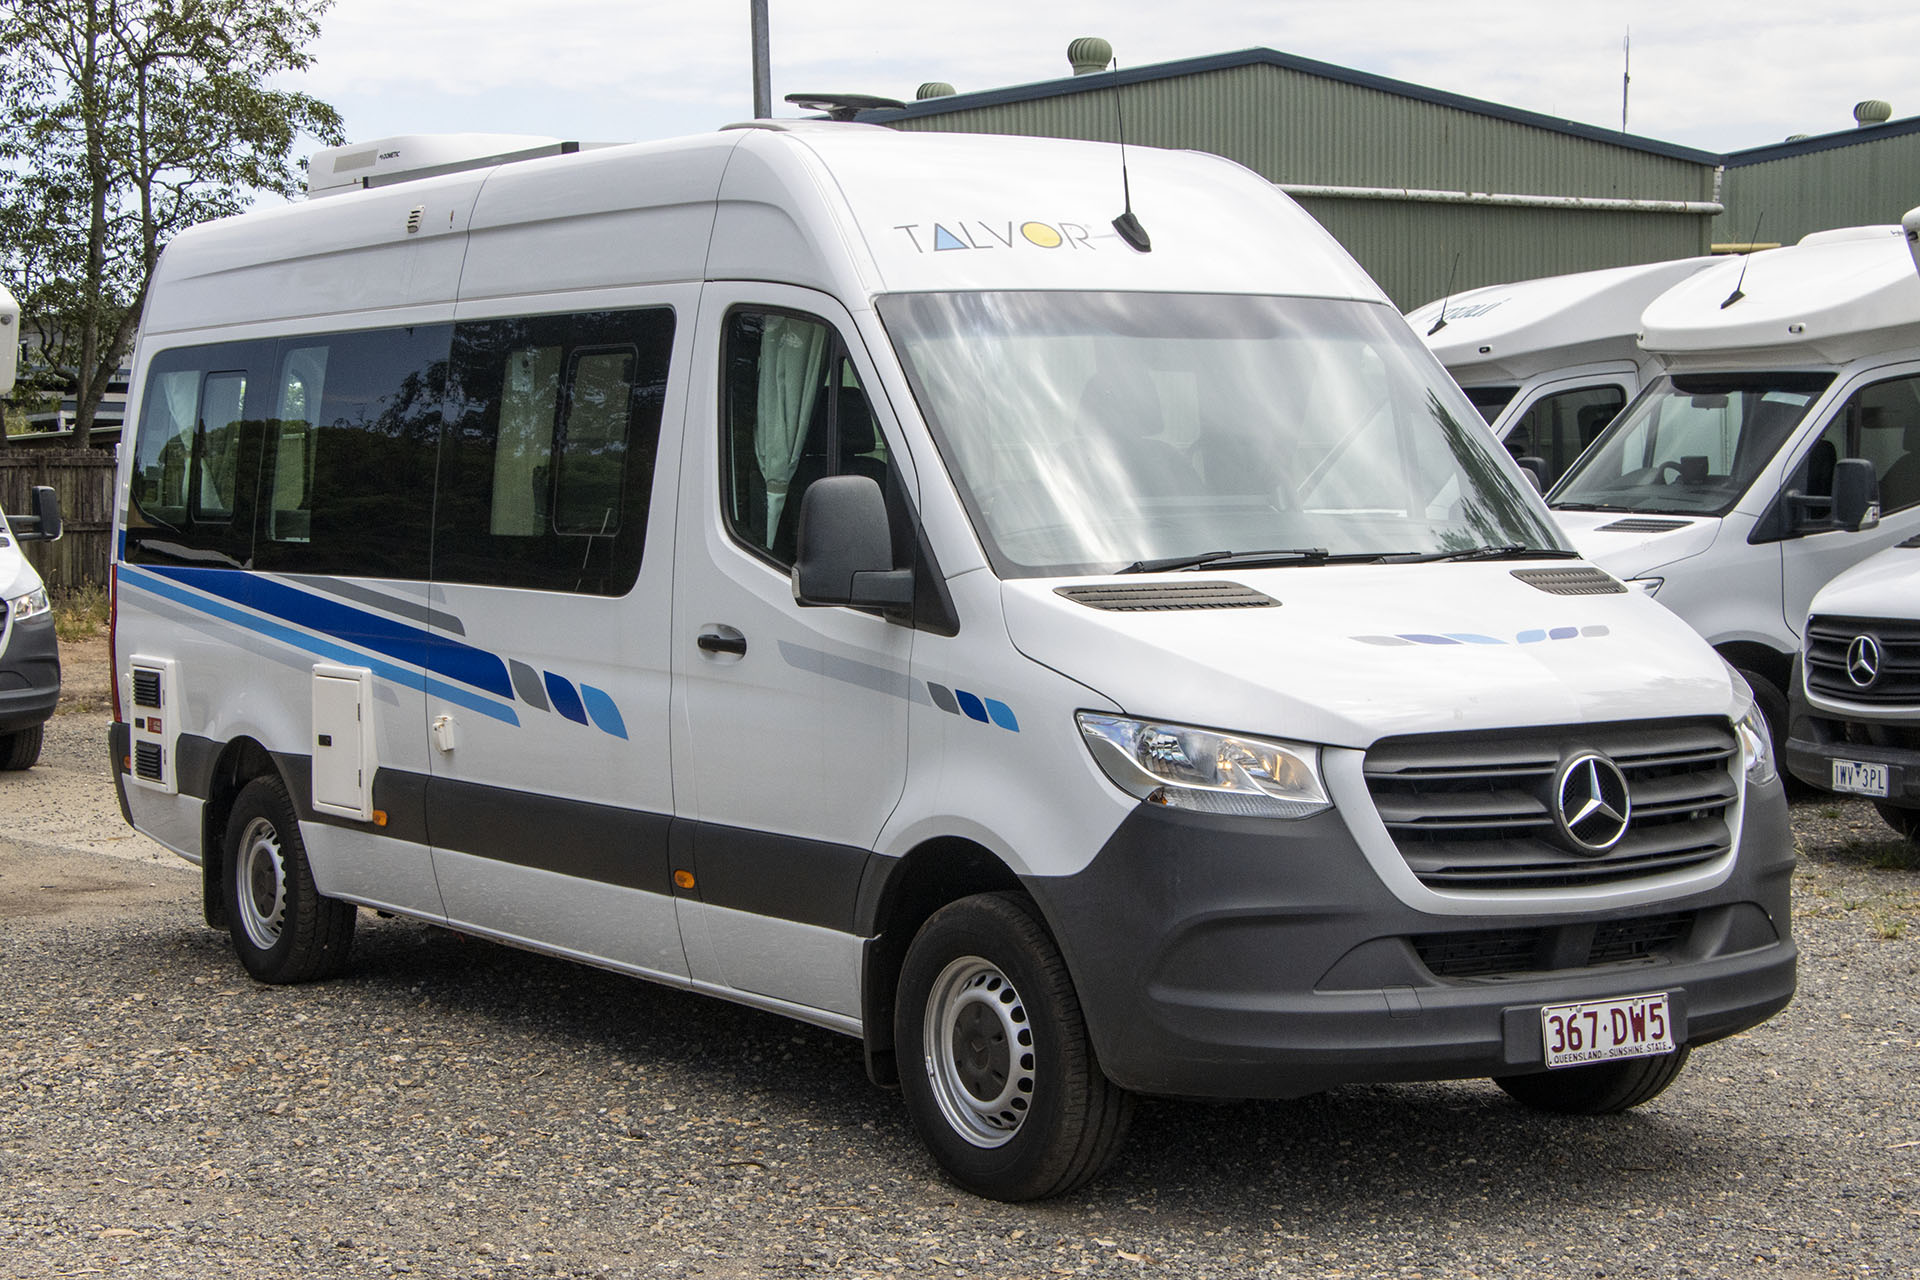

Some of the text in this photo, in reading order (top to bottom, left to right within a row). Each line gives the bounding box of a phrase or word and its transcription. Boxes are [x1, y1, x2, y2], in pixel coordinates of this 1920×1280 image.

[893, 221, 1096, 253] TALVOR
[1554, 1050, 1602, 1064] QUEENSLAND
[1609, 1045, 1644, 1057] SUNSHINE
[1646, 1041, 1667, 1053] STATE
